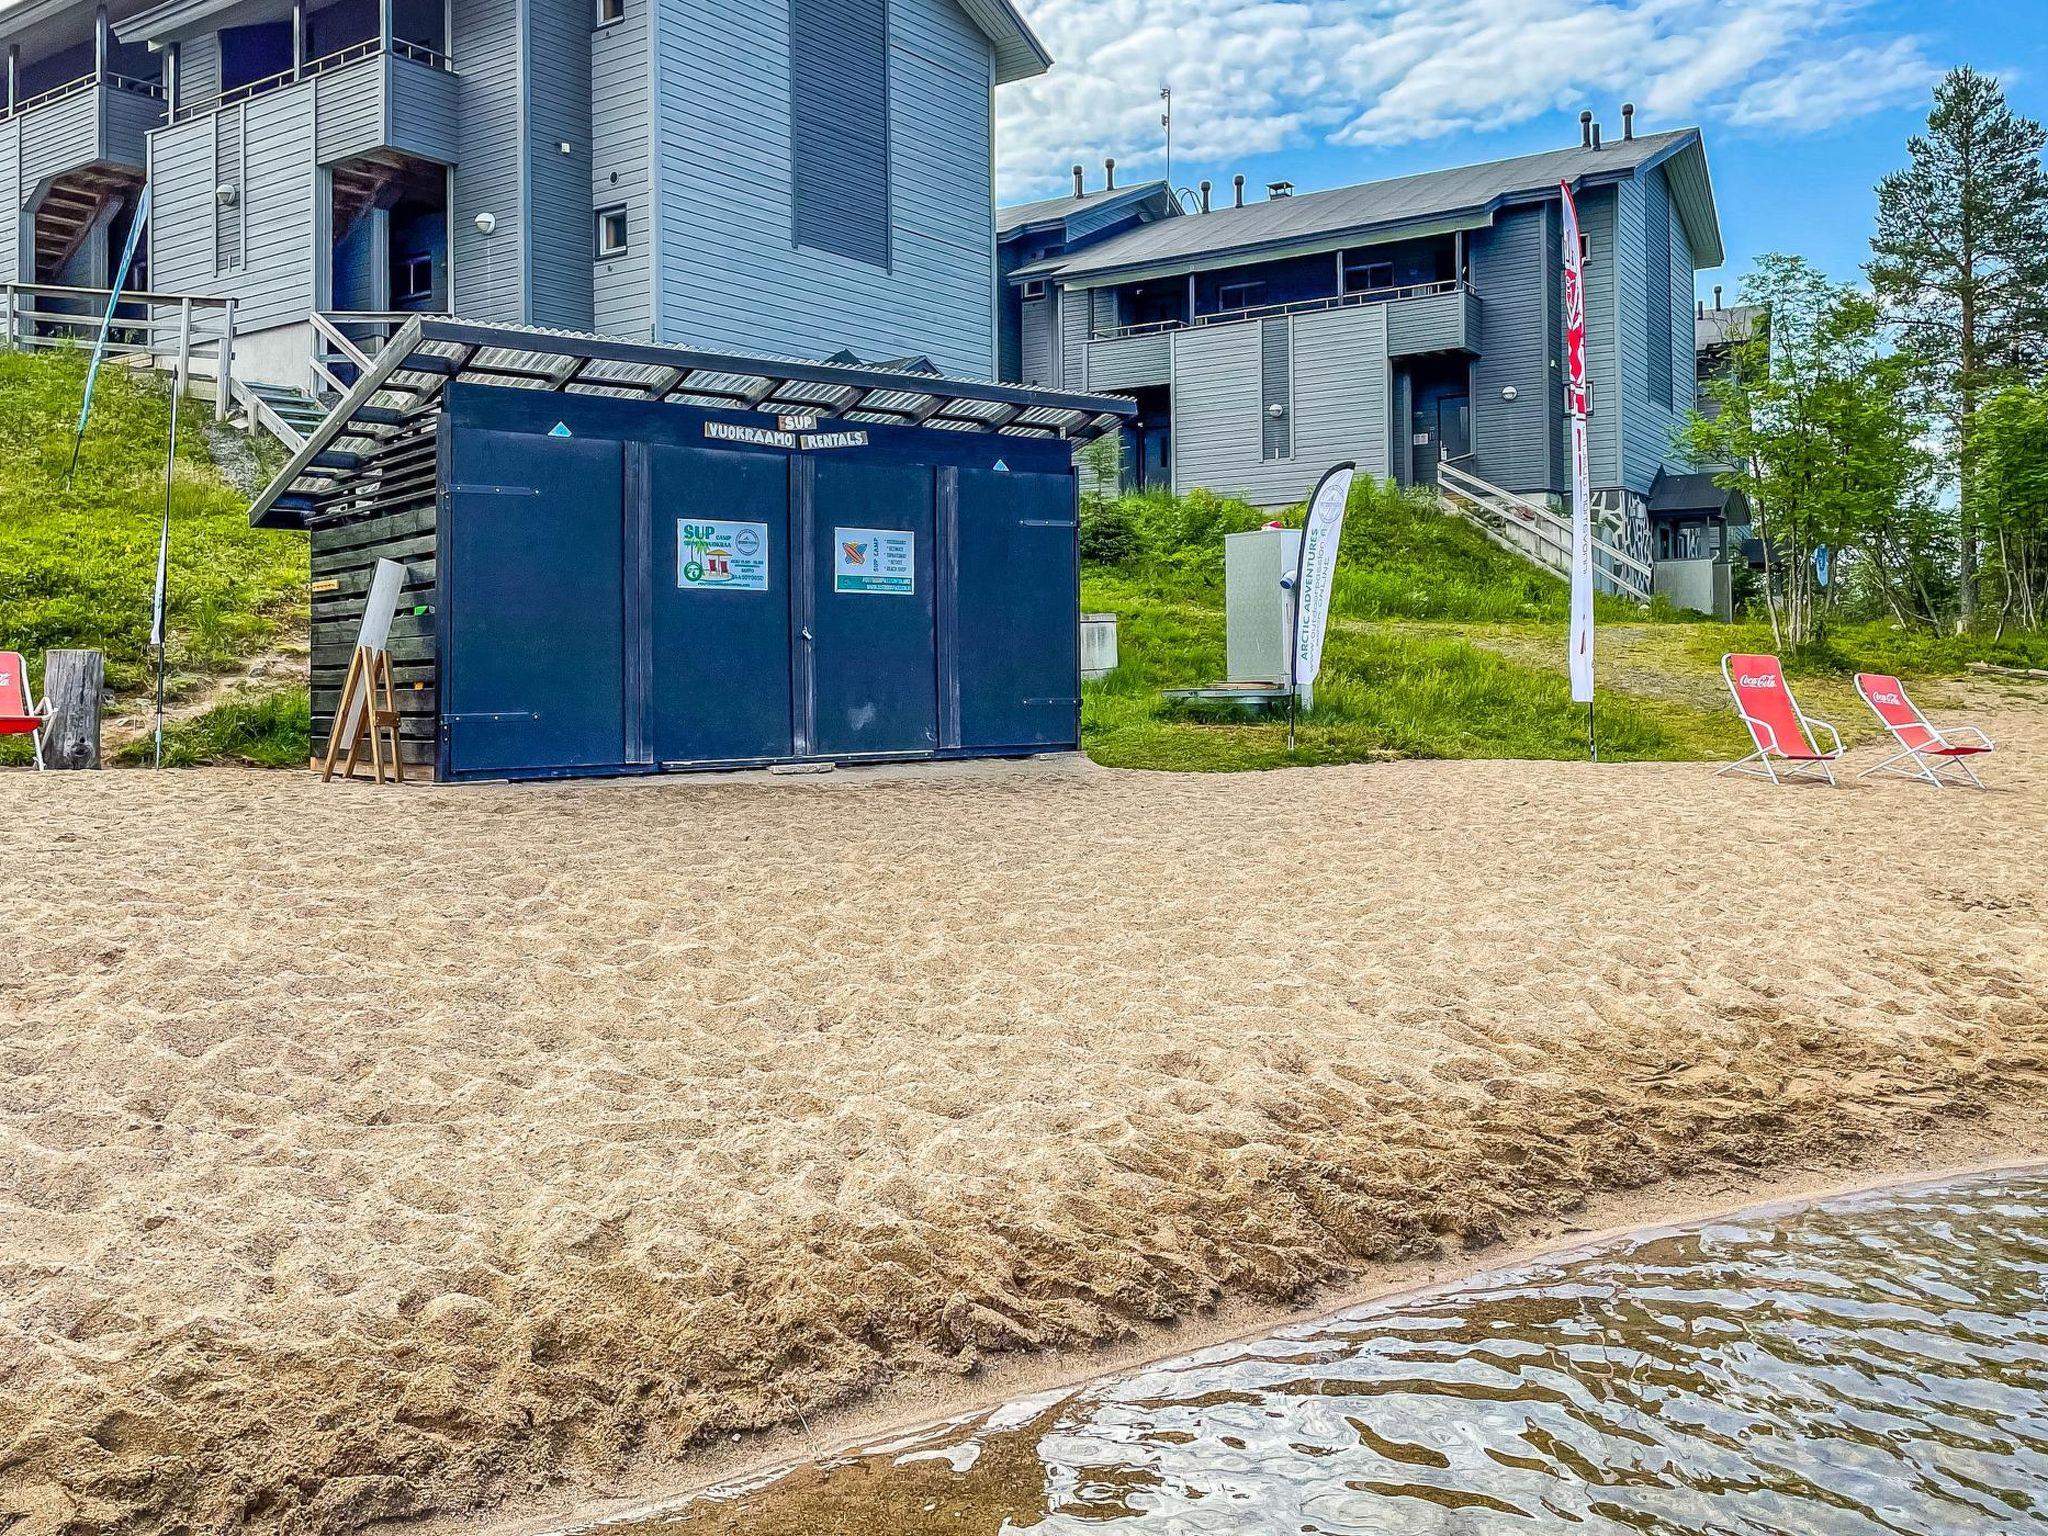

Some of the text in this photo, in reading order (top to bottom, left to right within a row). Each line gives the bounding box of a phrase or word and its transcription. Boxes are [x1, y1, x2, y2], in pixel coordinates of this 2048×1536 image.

[785, 415, 812, 429] SUP
[708, 422, 864, 448] VUOKRAAMO RENTALS
[683, 524, 715, 540] SUP
[1300, 528, 1318, 660] ARCTIC ADVENTURES
[1740, 674, 1776, 688] Coca-Cola
